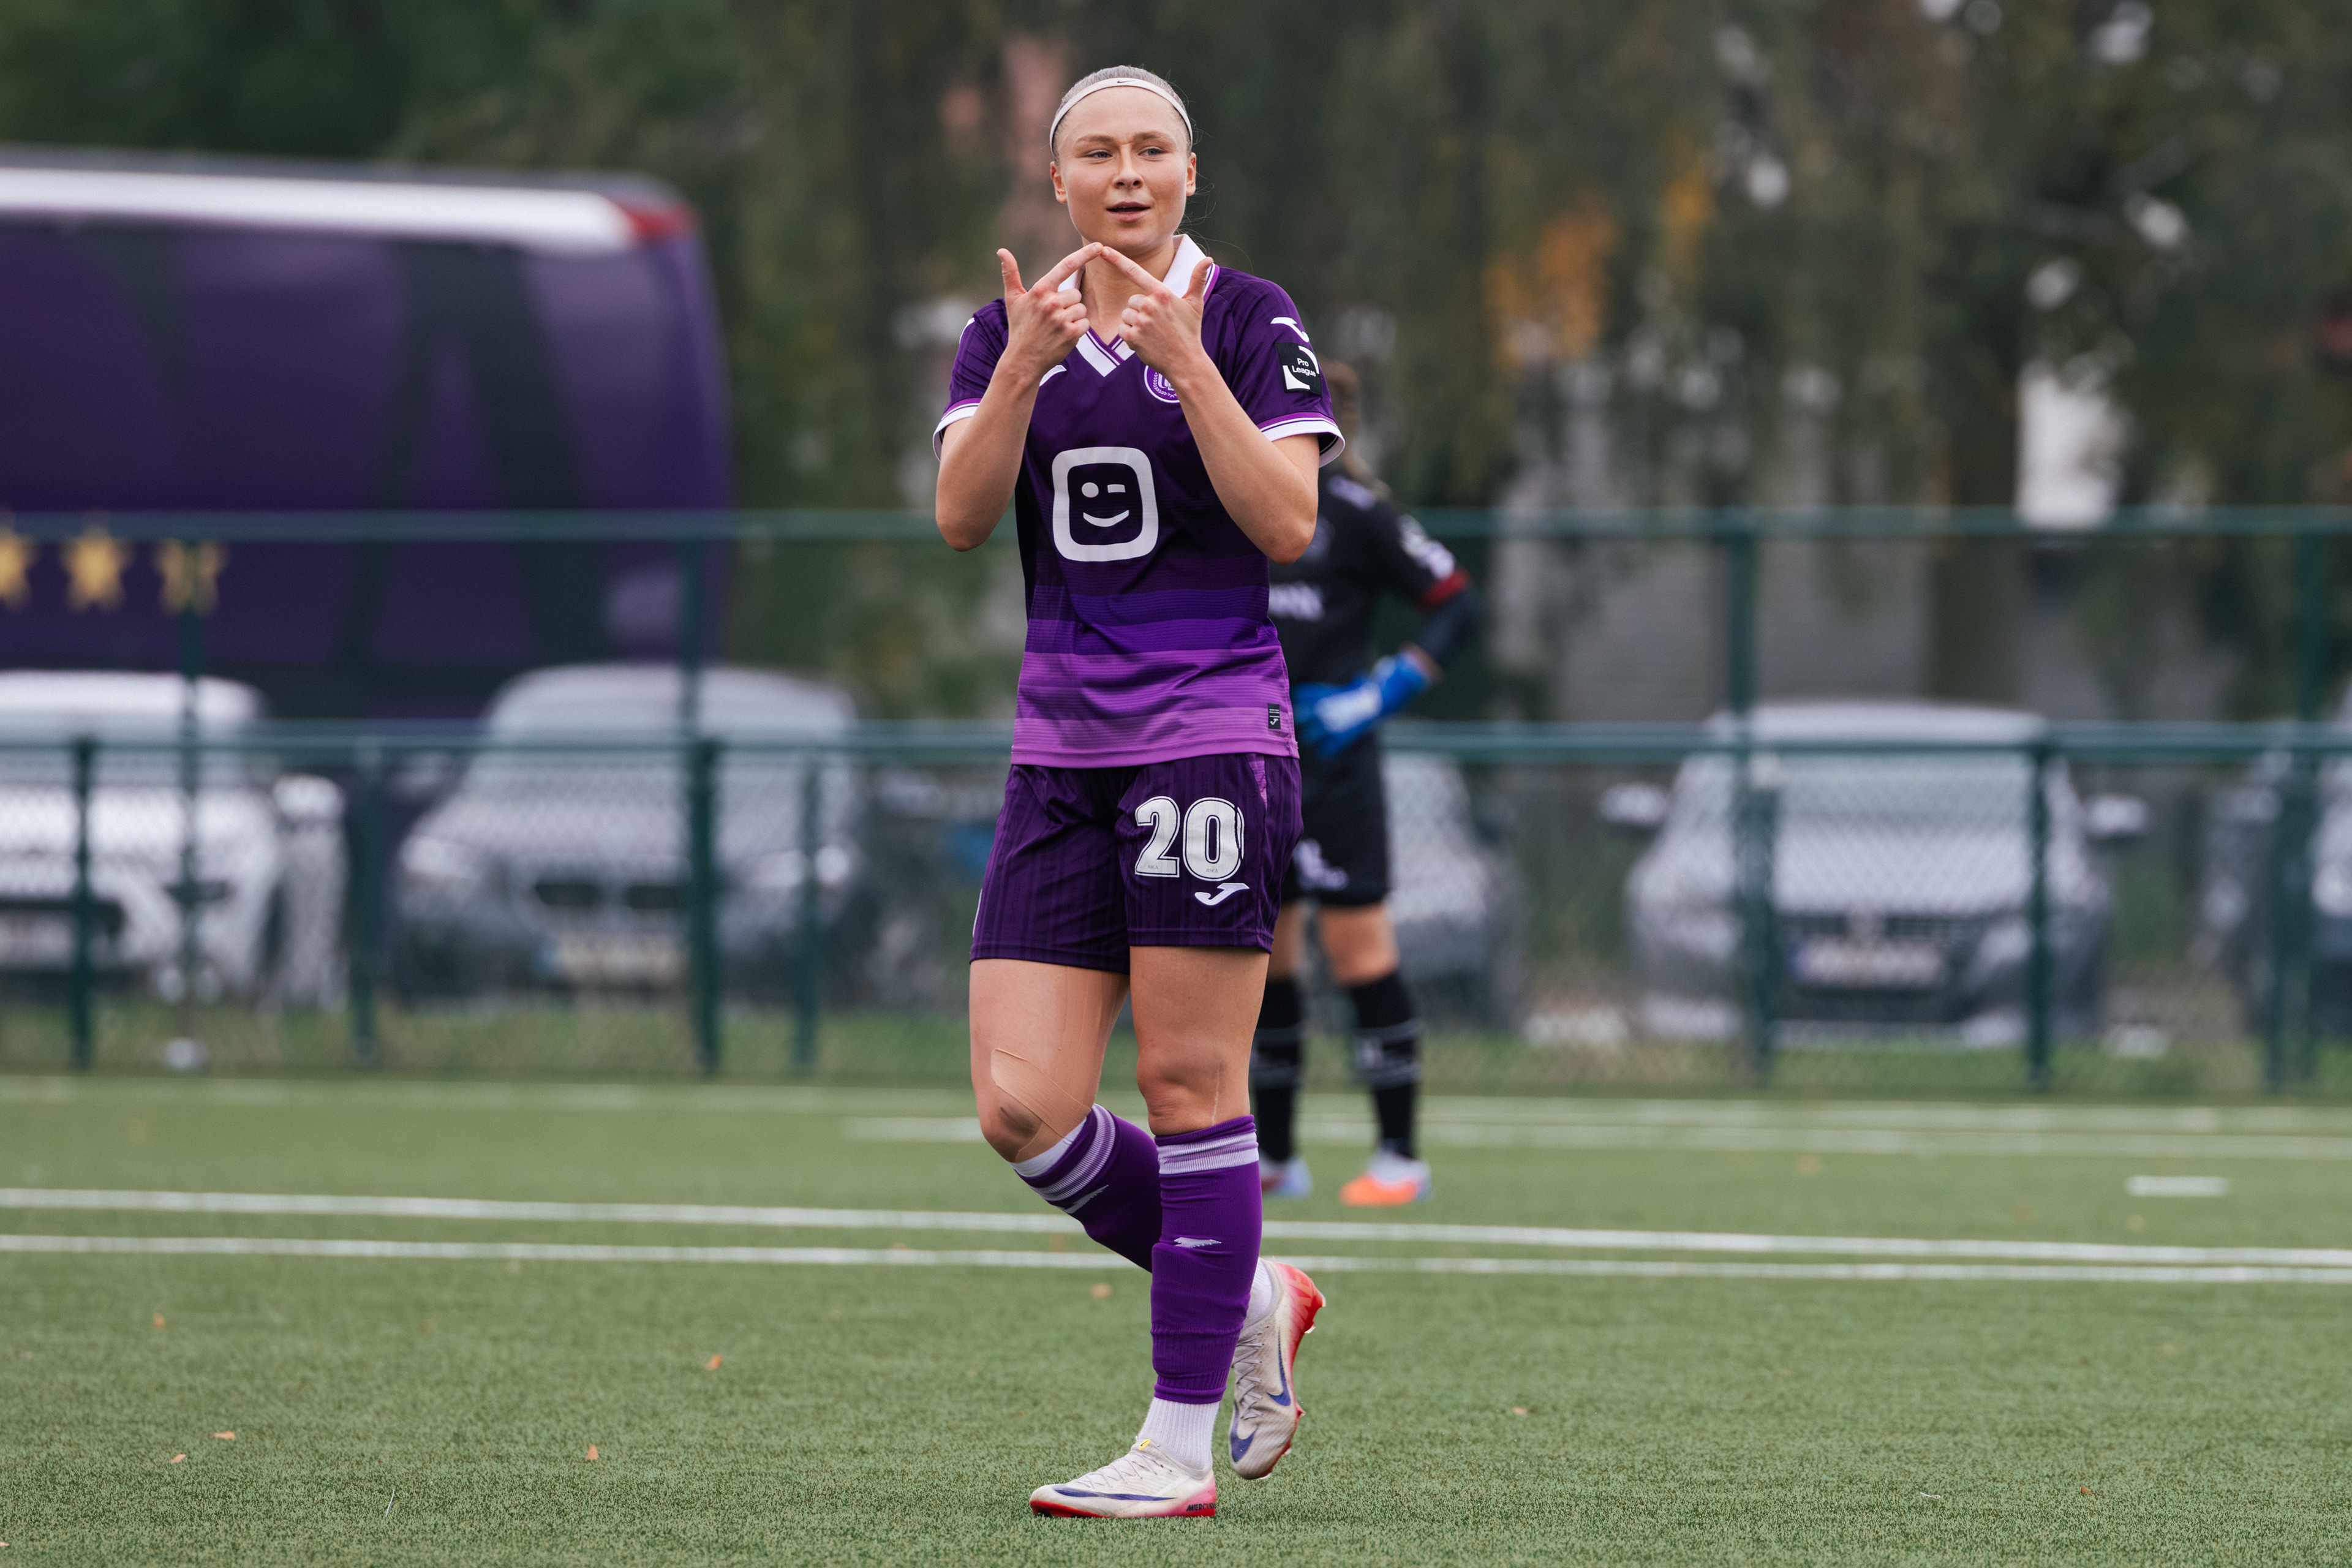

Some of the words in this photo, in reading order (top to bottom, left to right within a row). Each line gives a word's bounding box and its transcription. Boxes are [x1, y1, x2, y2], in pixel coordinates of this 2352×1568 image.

[1297, 358, 1310, 367] Pro
[1291, 365, 1316, 377] League
[1134, 796, 1245, 882] 20
